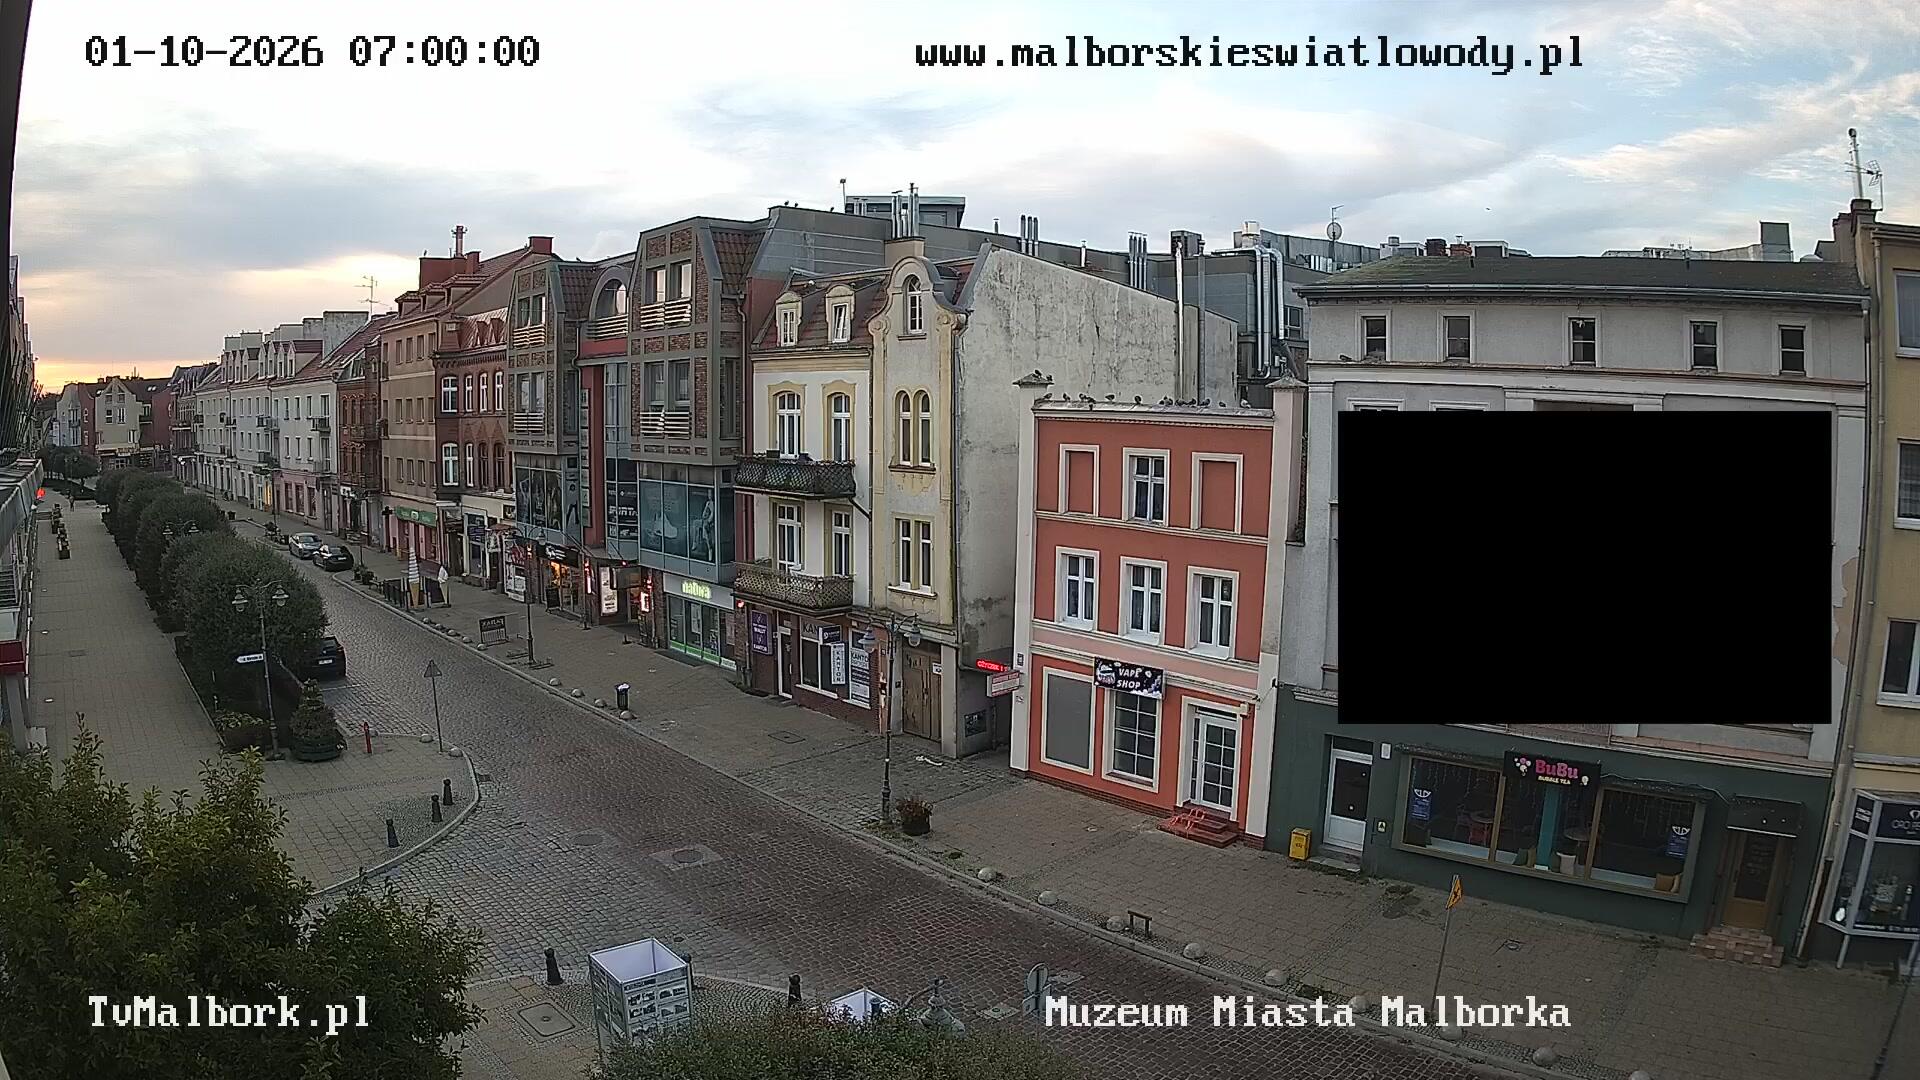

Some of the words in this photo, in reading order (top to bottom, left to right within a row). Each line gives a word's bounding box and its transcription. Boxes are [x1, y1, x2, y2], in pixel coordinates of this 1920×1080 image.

[1118, 667, 1140, 678] VAPE
[1116, 679, 1141, 689] SHOP
[1535, 759, 1579, 779] BuBu
[1537, 775, 1560, 784] BUBBLE
